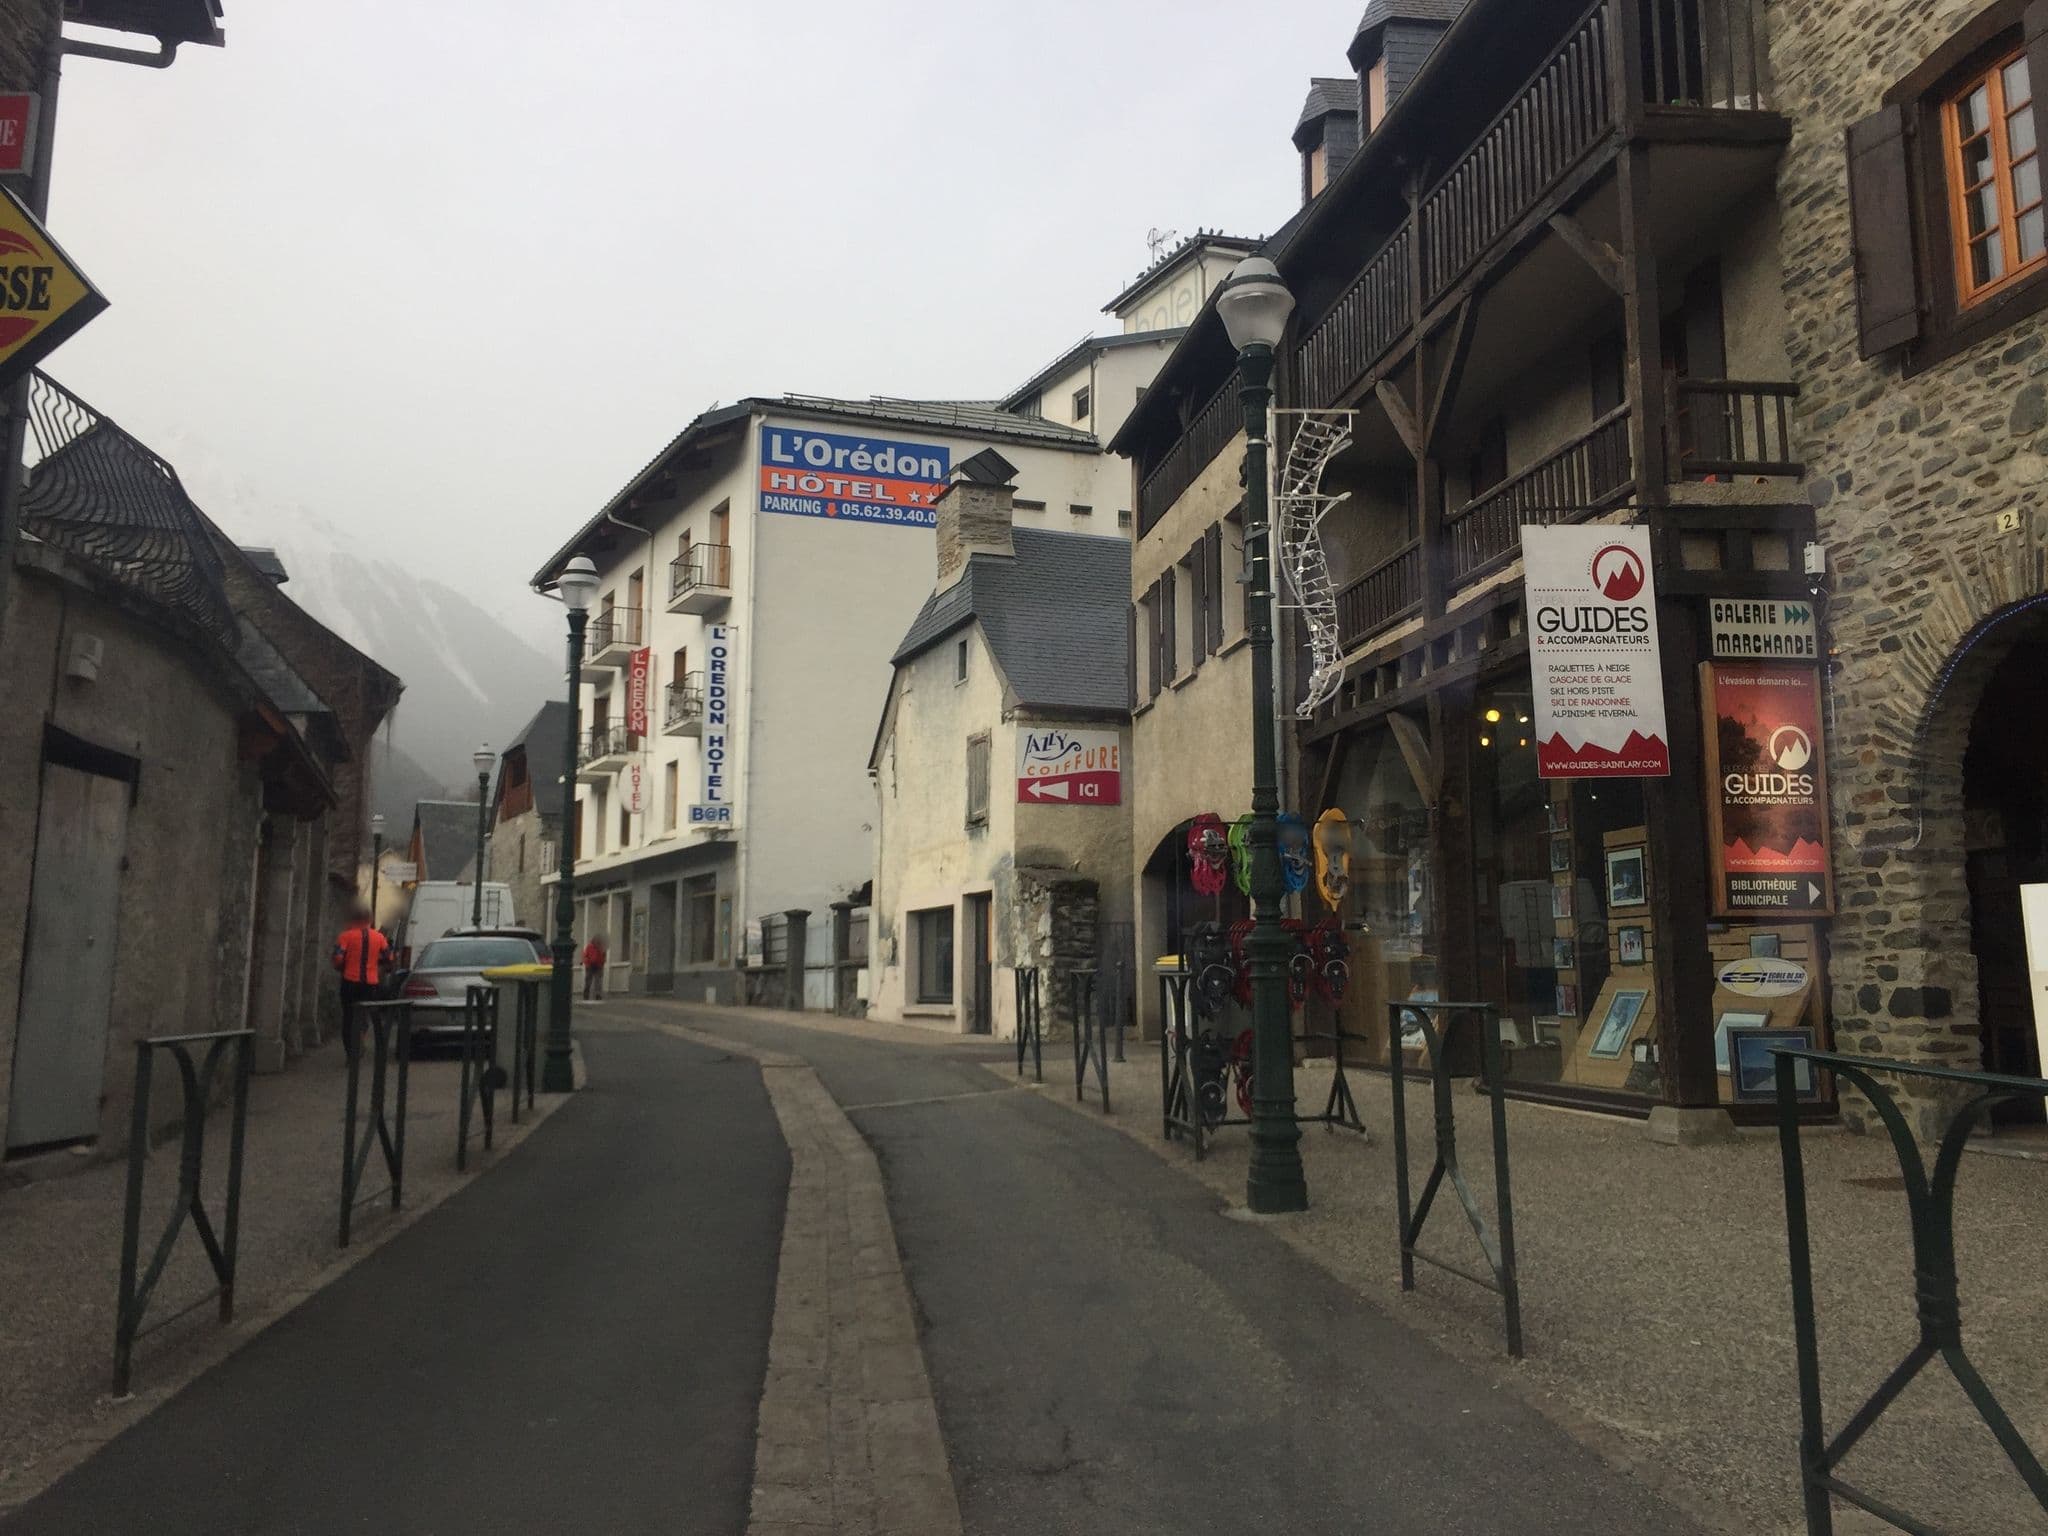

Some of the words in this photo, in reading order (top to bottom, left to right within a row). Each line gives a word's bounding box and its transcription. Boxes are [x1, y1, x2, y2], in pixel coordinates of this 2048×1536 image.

[0, 119, 18, 146] E
[771, 434, 942, 479] L'Orédon
[770, 472, 896, 502] HÔTEL
[764, 495, 822, 514] PARKING
[2003, 514, 2013, 530] 2
[1536, 606, 1649, 633] GUIDES
[1714, 603, 1776, 624] GALERIE
[1537, 635, 1545, 645] &
[1547, 635, 1650, 645] ACCOMPAGNATEURS
[1716, 633, 1814, 654] MARCHANDE
[1548, 664, 1595, 673] RAQUETTES
[1605, 664, 1631, 673] NEIGE
[1549, 675, 1589, 684] CASCADE
[1590, 675, 1602, 684] DE
[1603, 675, 1632, 684] GLACE
[1718, 675, 1755, 686] L'évasion
[1757, 676, 1790, 687] démarre
[1550, 687, 1565, 696] SKI
[1567, 687, 1590, 696] HORS
[1592, 687, 1616, 695] PISTE
[1551, 698, 1566, 707] SKI
[1568, 698, 1579, 707] DE
[1551, 709, 1596, 718] ALPINISME
[1598, 709, 1639, 718] HIVERNAL
[707, 735, 725, 801] HOTEL
[1027, 745, 1119, 776] COIFFURE
[631, 764, 641, 815] HOTEL
[1079, 783, 1099, 797] ICI
[1724, 773, 1813, 796] GUIDES
[1732, 796, 1814, 805] ACCOMPAGNATEURS
[1731, 878, 1798, 892] BIBLIOTHÈQUE
[1732, 895, 1789, 906] MUNICIPALE
